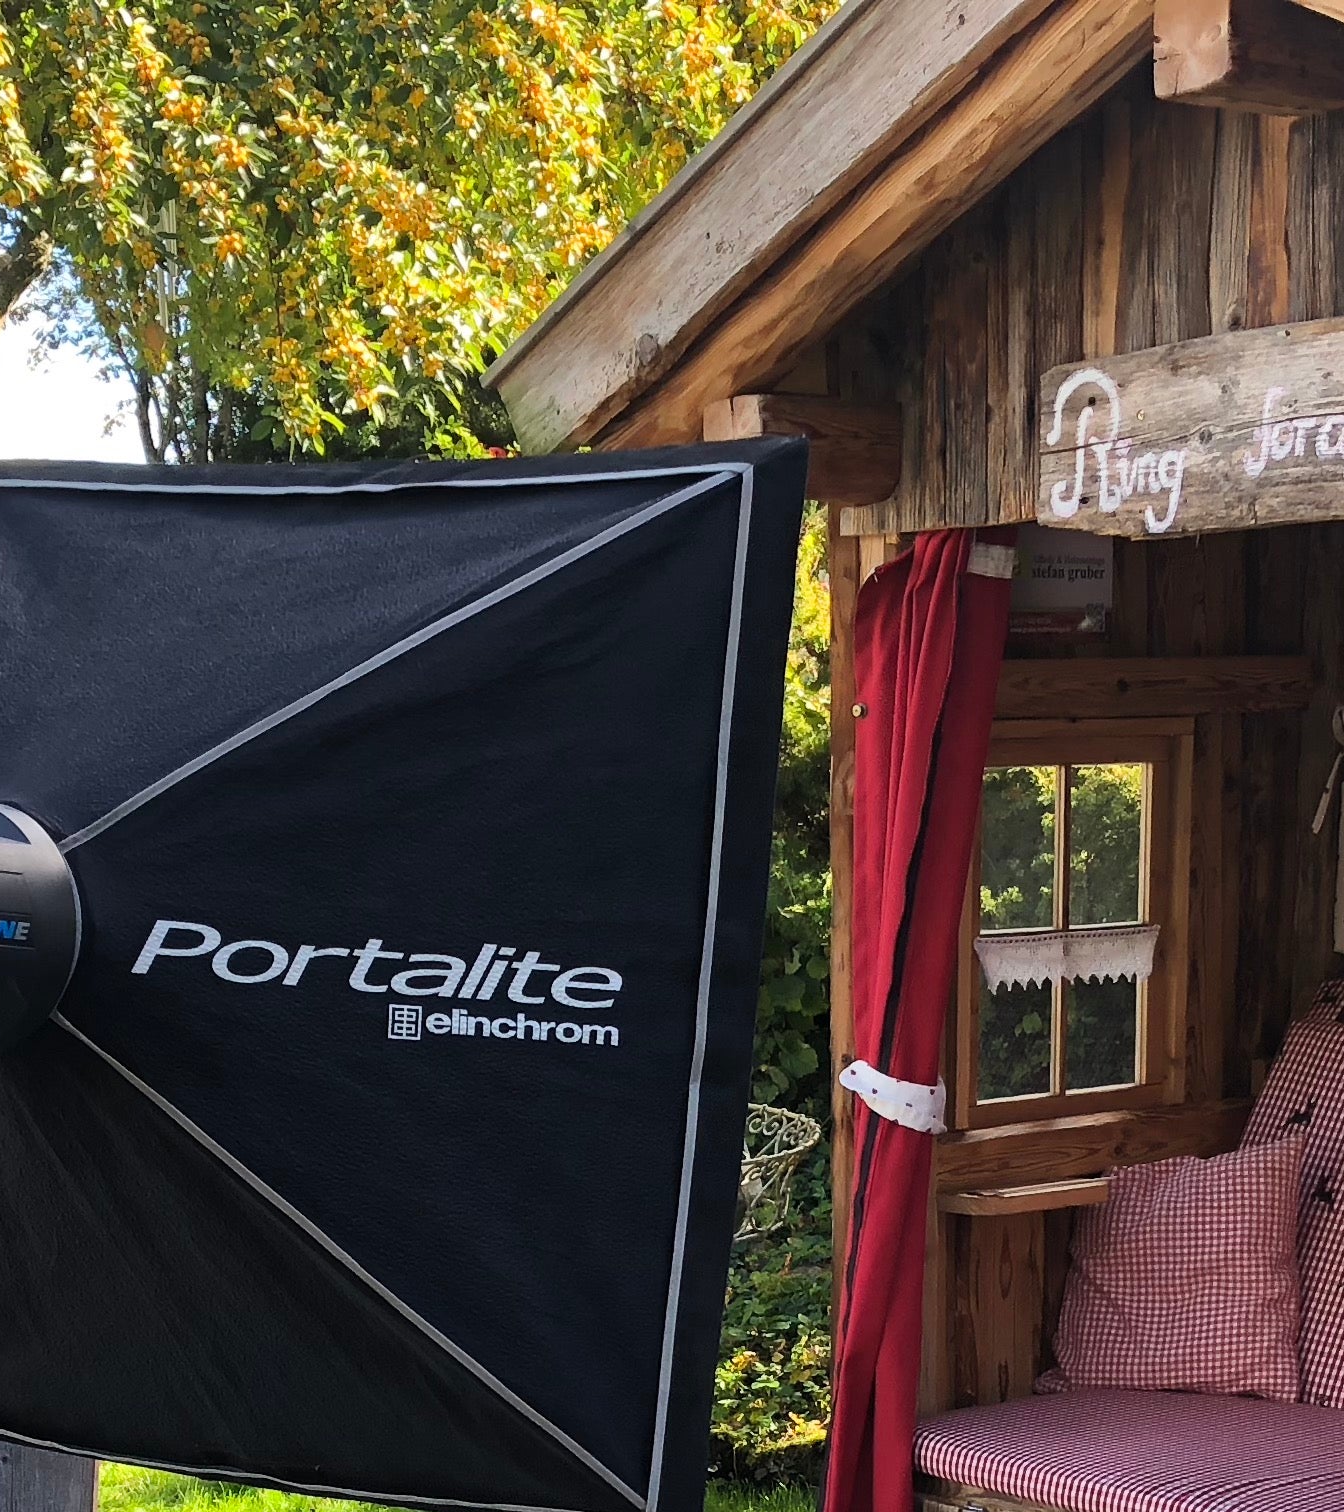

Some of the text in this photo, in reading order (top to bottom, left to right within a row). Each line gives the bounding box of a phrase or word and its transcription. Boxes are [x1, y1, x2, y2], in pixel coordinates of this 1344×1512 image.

[1046, 367, 1185, 533] Ring
[131, 919, 623, 1008] Portalite
[425, 1008, 619, 1046] elinchrom
